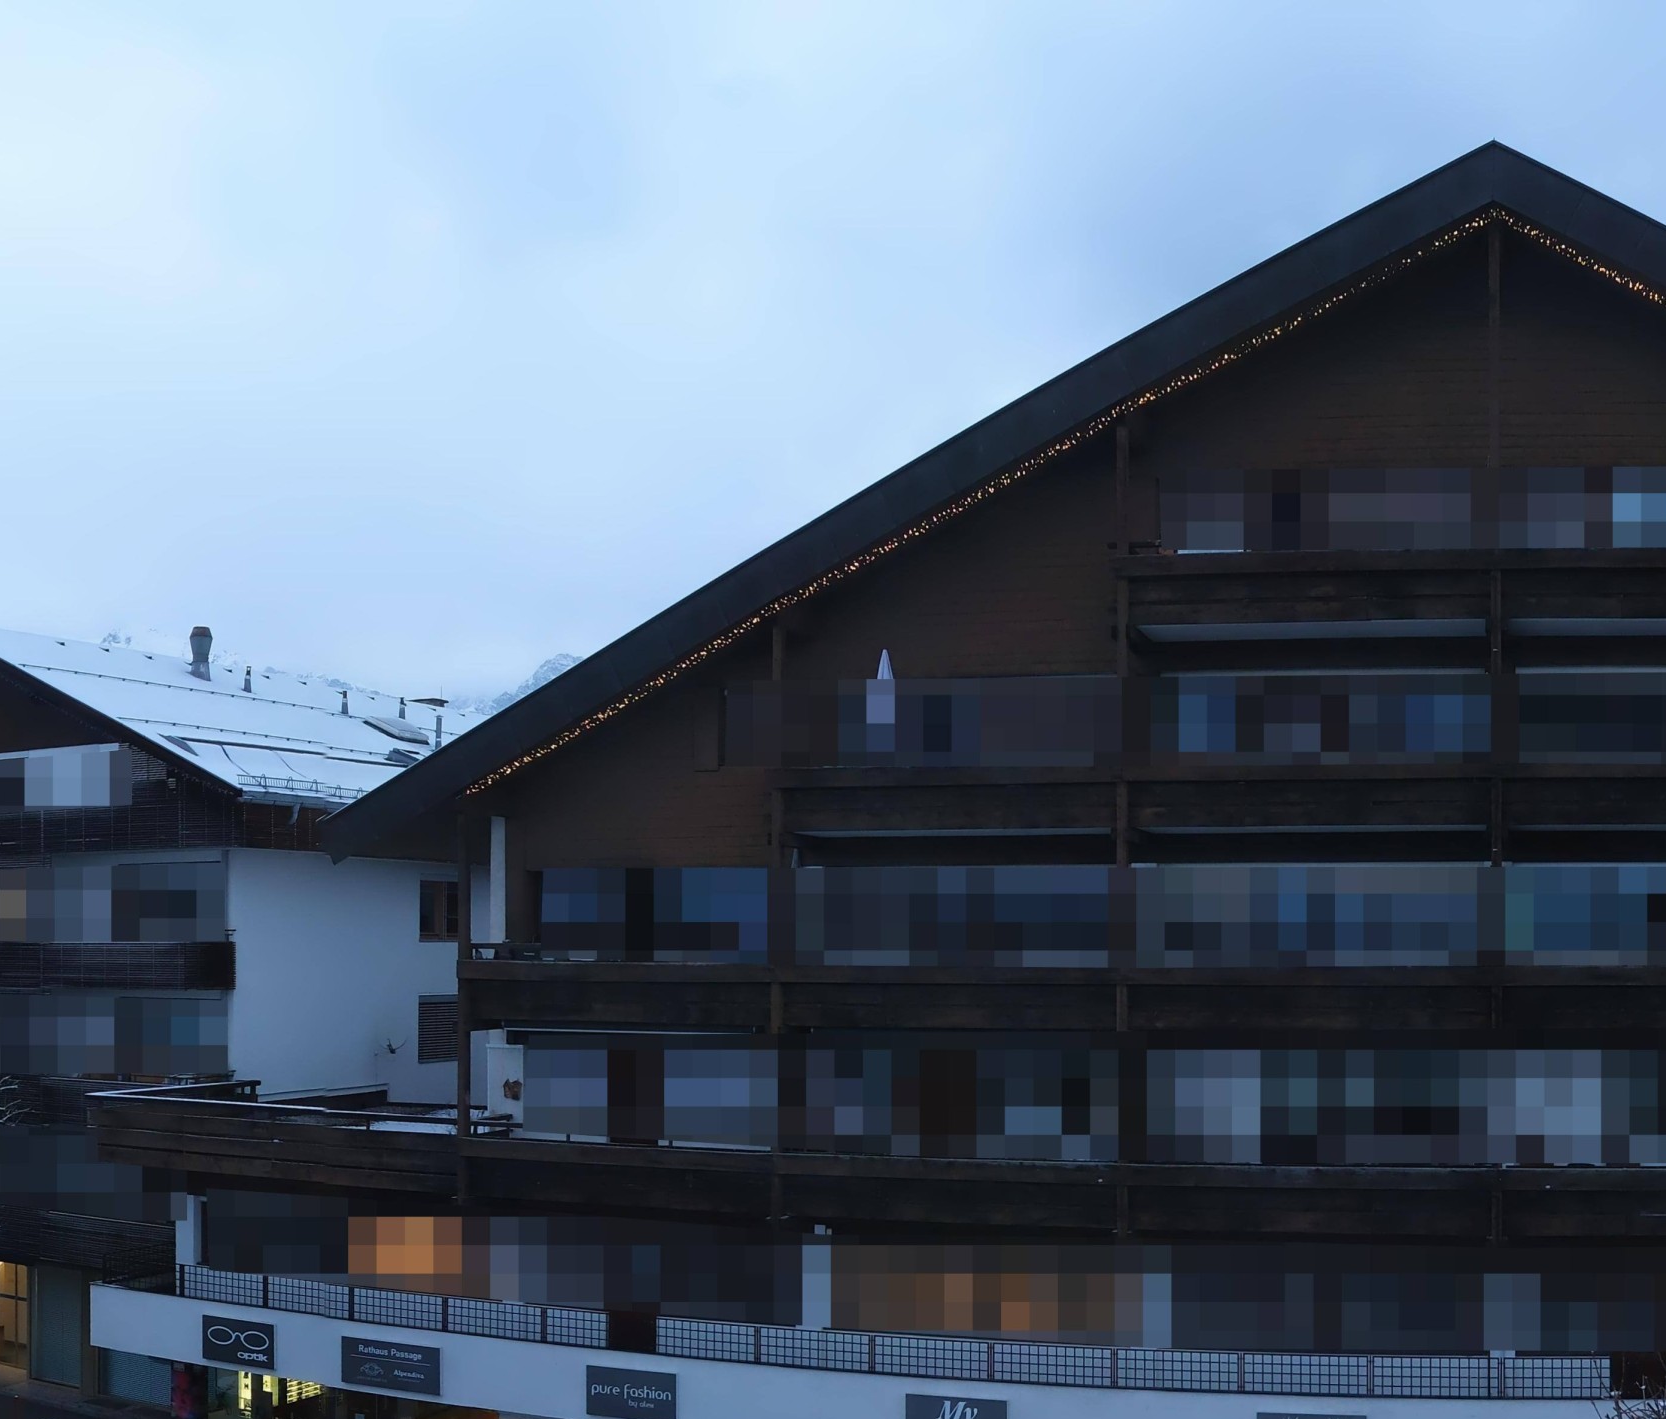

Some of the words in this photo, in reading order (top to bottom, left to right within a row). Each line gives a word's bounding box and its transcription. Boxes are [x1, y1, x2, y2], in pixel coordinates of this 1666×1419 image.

[237, 1350, 269, 1363] optik
[358, 1344, 389, 1357] Rathaus
[390, 1348, 423, 1361] Passage
[393, 1368, 425, 1380] Alpendiva
[591, 1384, 621, 1396] pure
[623, 1383, 672, 1401] fashion
[628, 1399, 638, 1409] by
